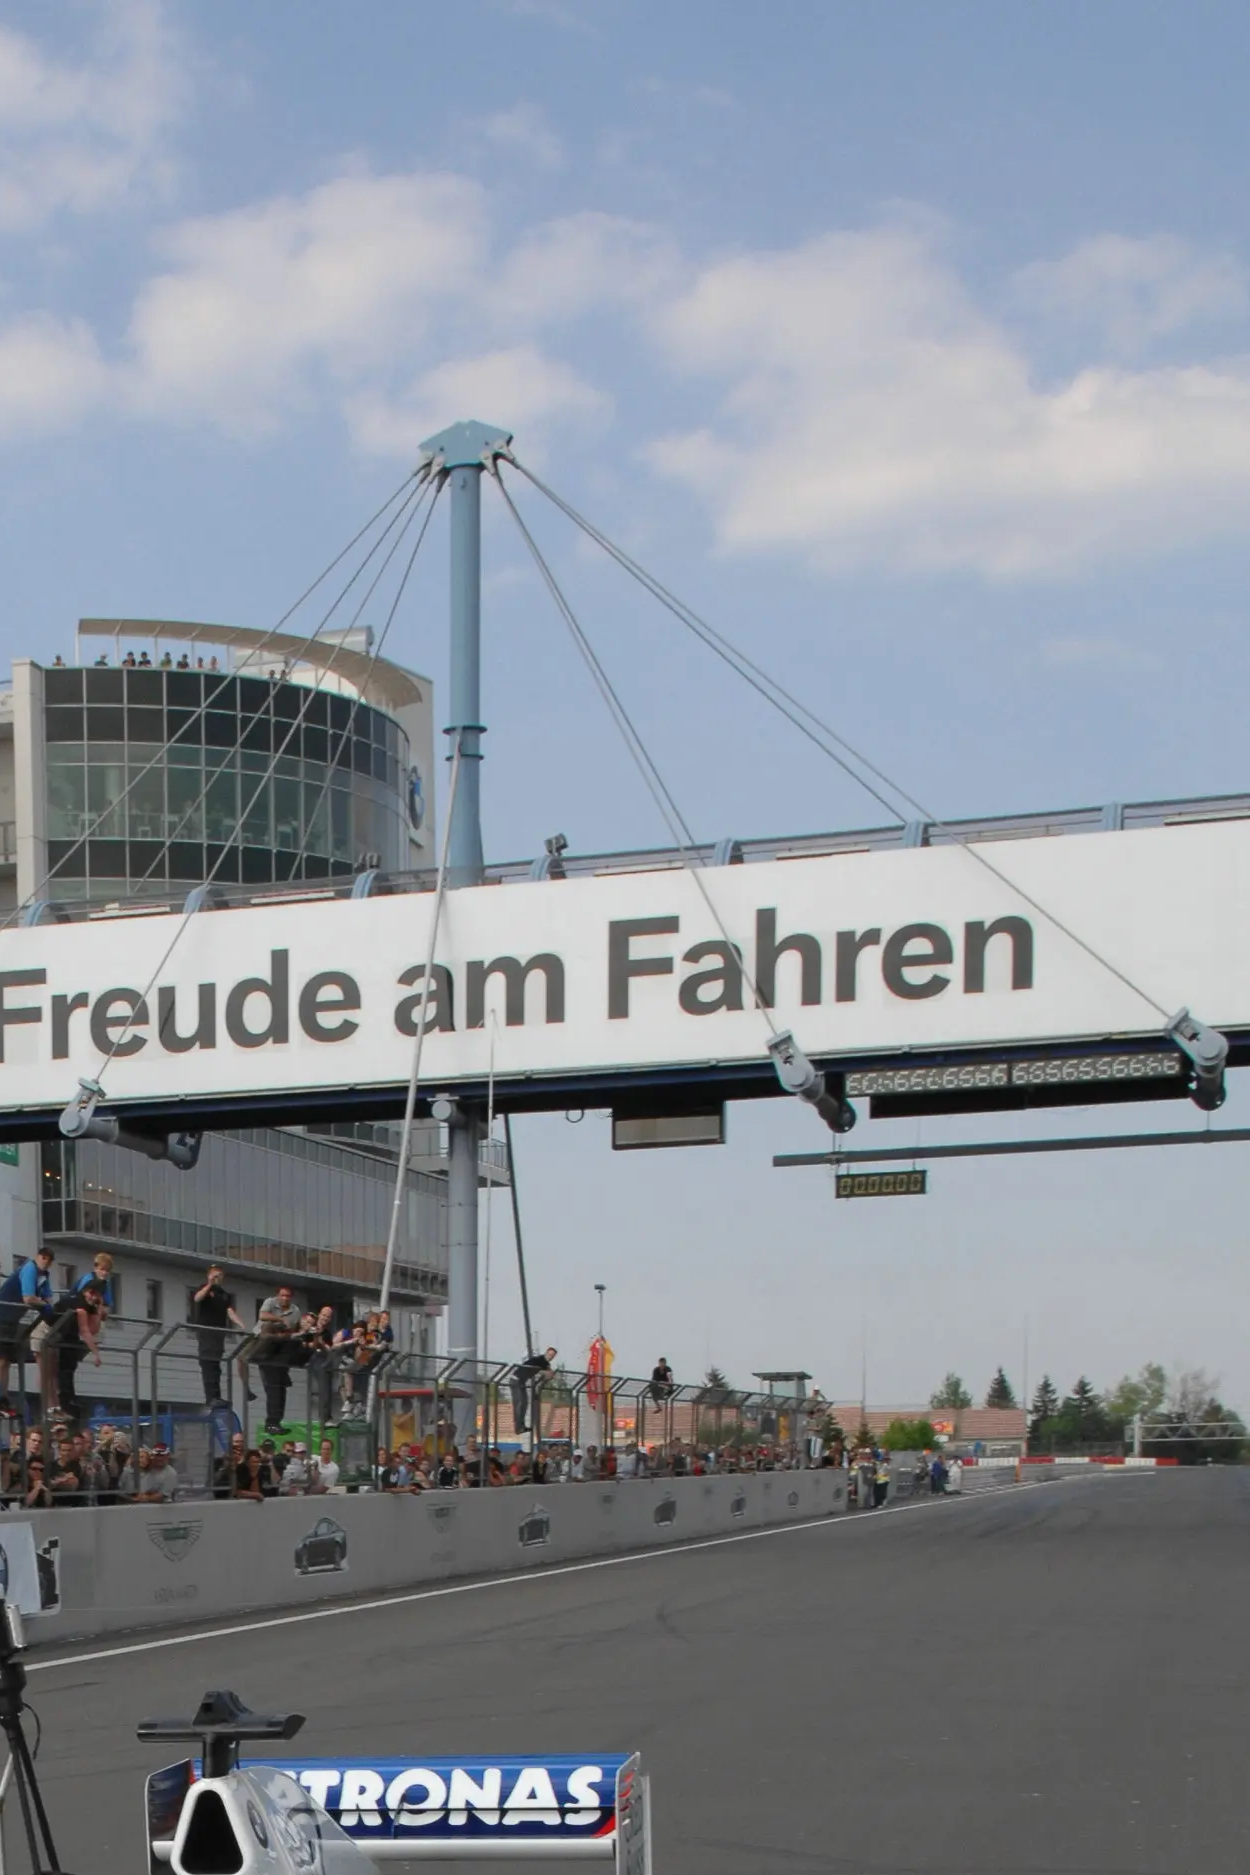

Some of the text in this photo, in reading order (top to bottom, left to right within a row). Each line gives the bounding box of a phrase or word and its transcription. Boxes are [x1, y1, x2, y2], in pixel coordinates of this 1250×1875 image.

[395, 950, 566, 1038] am
[607, 907, 1034, 1021] Fahren
[293, 1765, 603, 1827] TRONAS
